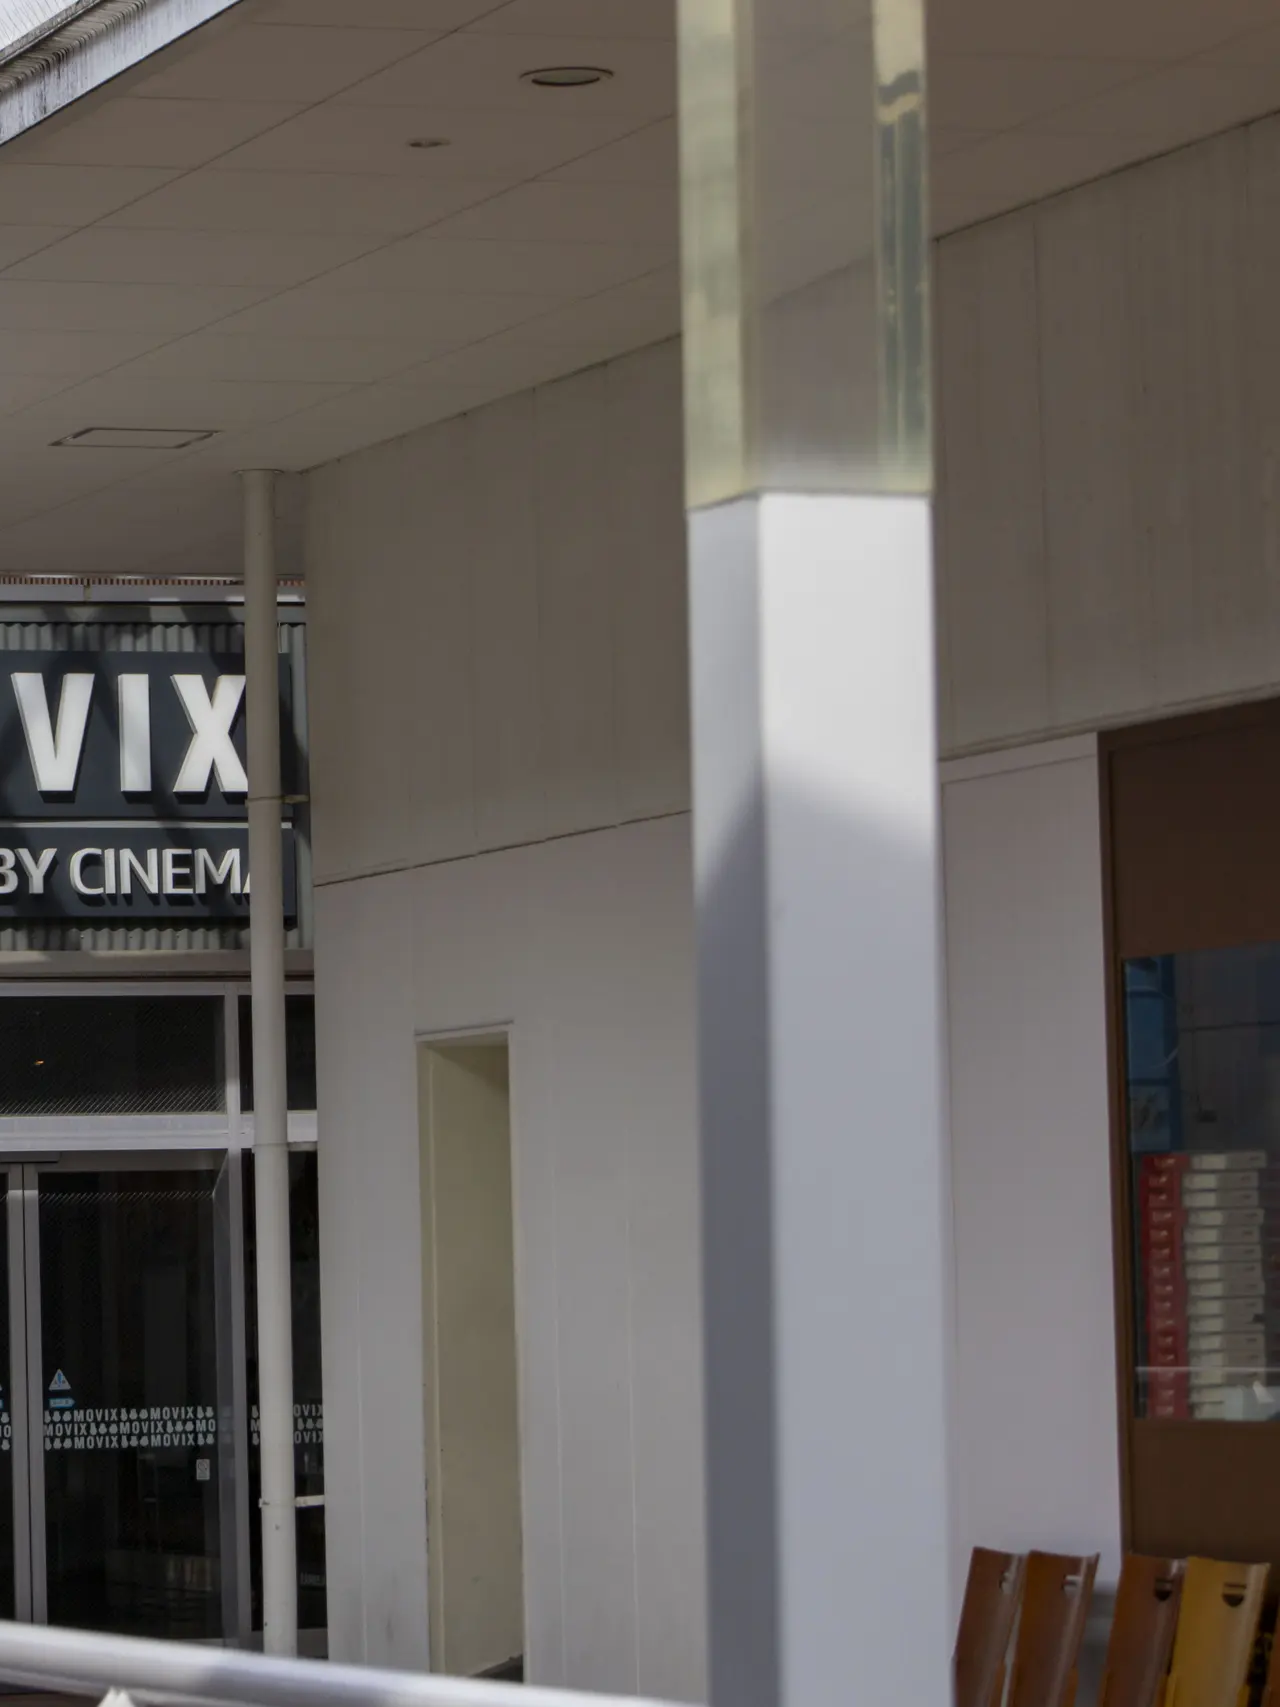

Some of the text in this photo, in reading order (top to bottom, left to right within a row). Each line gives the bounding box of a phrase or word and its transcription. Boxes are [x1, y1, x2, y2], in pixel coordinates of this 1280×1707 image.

[69, 847, 250, 896] CINEM
[73, 1406, 194, 1422] MOVIX MOVIX
[293, 1404, 323, 1417] OVIX
[44, 1422, 88, 1437] MOVIX
[120, 1420, 164, 1434] MOVIX
[74, 1433, 195, 1449] MOVIX MOVIX
